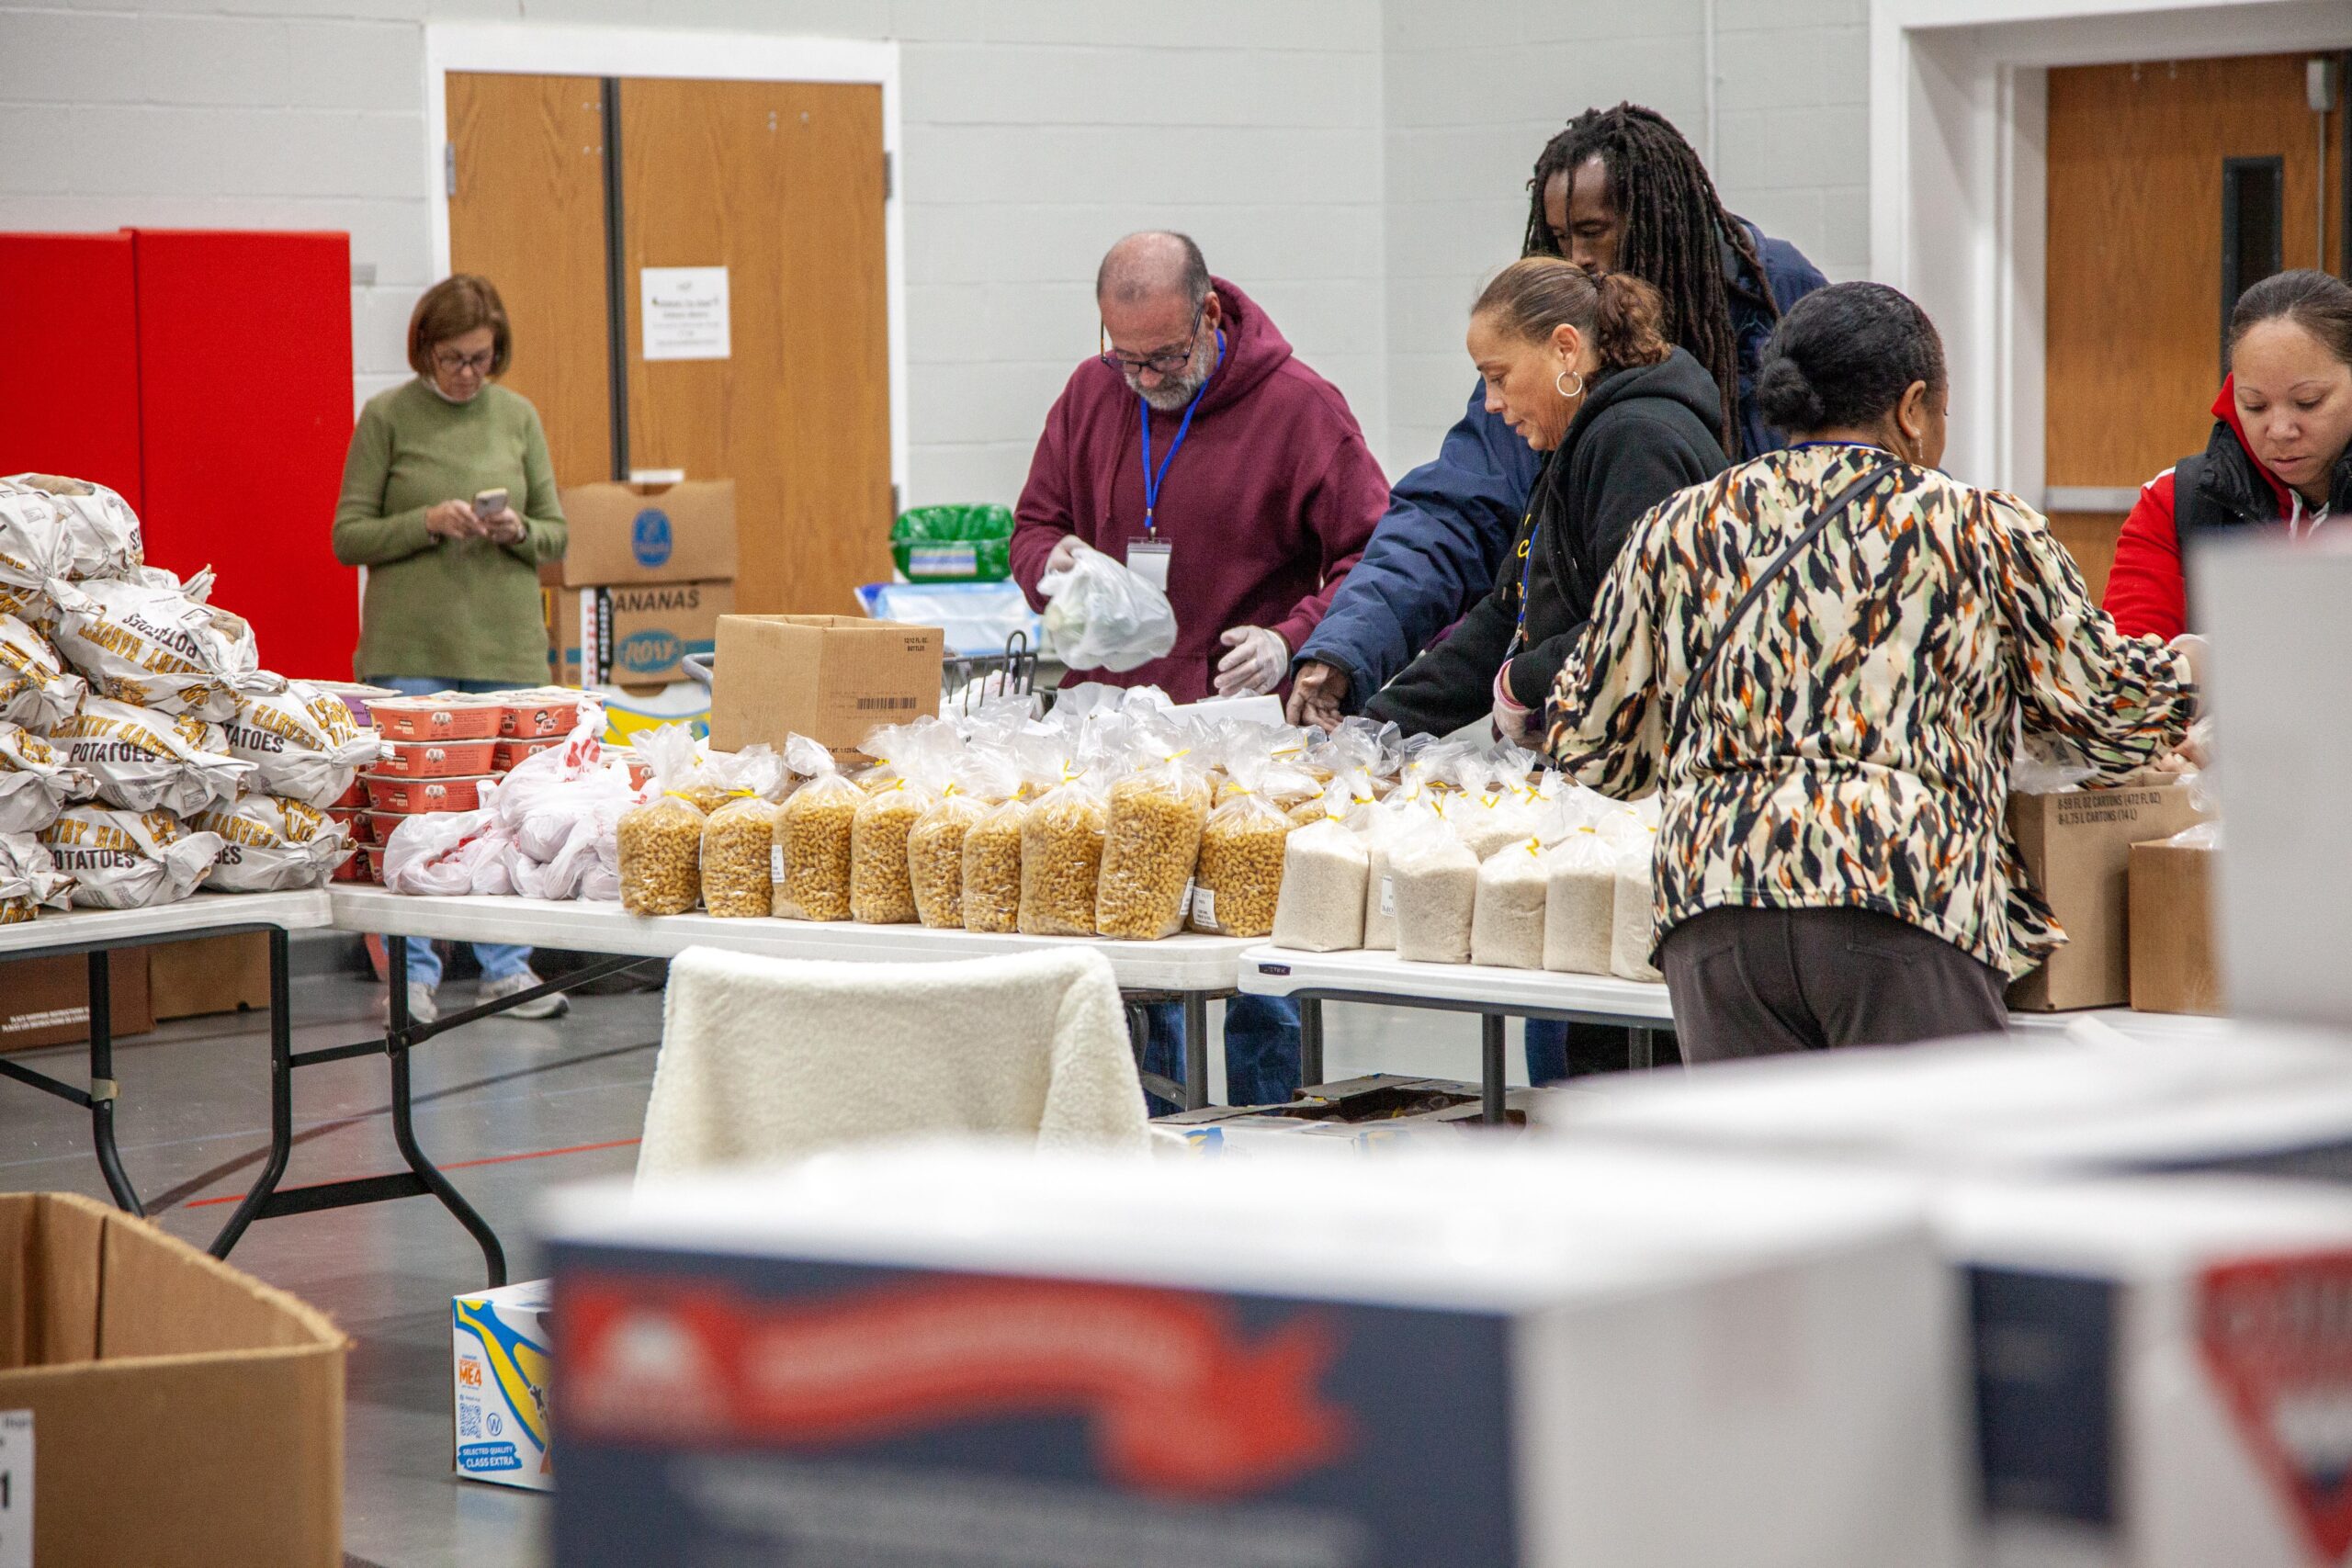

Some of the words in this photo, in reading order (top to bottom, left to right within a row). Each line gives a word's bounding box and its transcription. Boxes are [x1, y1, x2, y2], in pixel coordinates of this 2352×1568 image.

[2074, 796, 2082, 809] FL
[2092, 795, 2122, 808] CARTONS
[2141, 793, 2148, 805] FL
[2086, 810, 2117, 823] CARTONS
[51, 850, 136, 871] OTATOES
[462, 1448, 489, 1456] SELECTED
[490, 1446, 514, 1455] QUALITY
[466, 1457, 489, 1468] CLASS
[490, 1456, 514, 1467] EXTRA
